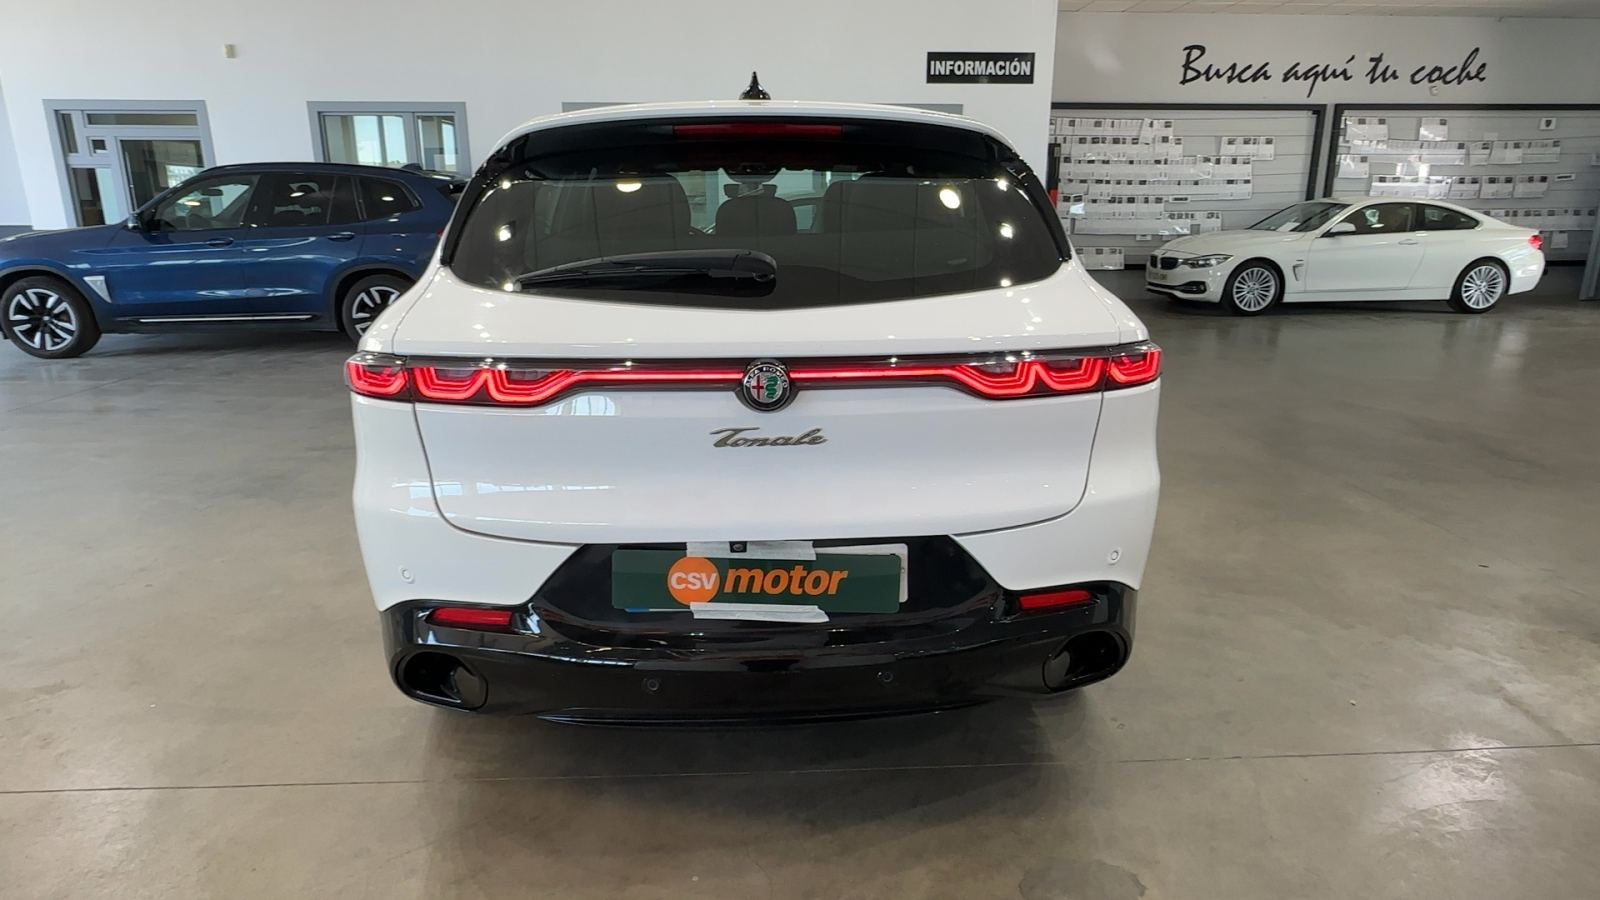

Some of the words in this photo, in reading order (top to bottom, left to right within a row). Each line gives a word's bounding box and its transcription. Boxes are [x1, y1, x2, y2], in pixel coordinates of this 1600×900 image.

[929, 57, 1032, 76] INFORMACIÓN
[1179, 44, 1272, 86] Busca
[1281, 54, 1356, 99] aquí
[1365, 52, 1400, 85] tu
[1409, 47, 1487, 85] coche
[709, 426, 828, 449] Tonale
[670, 571, 717, 591] CSV
[723, 564, 849, 596] motor
